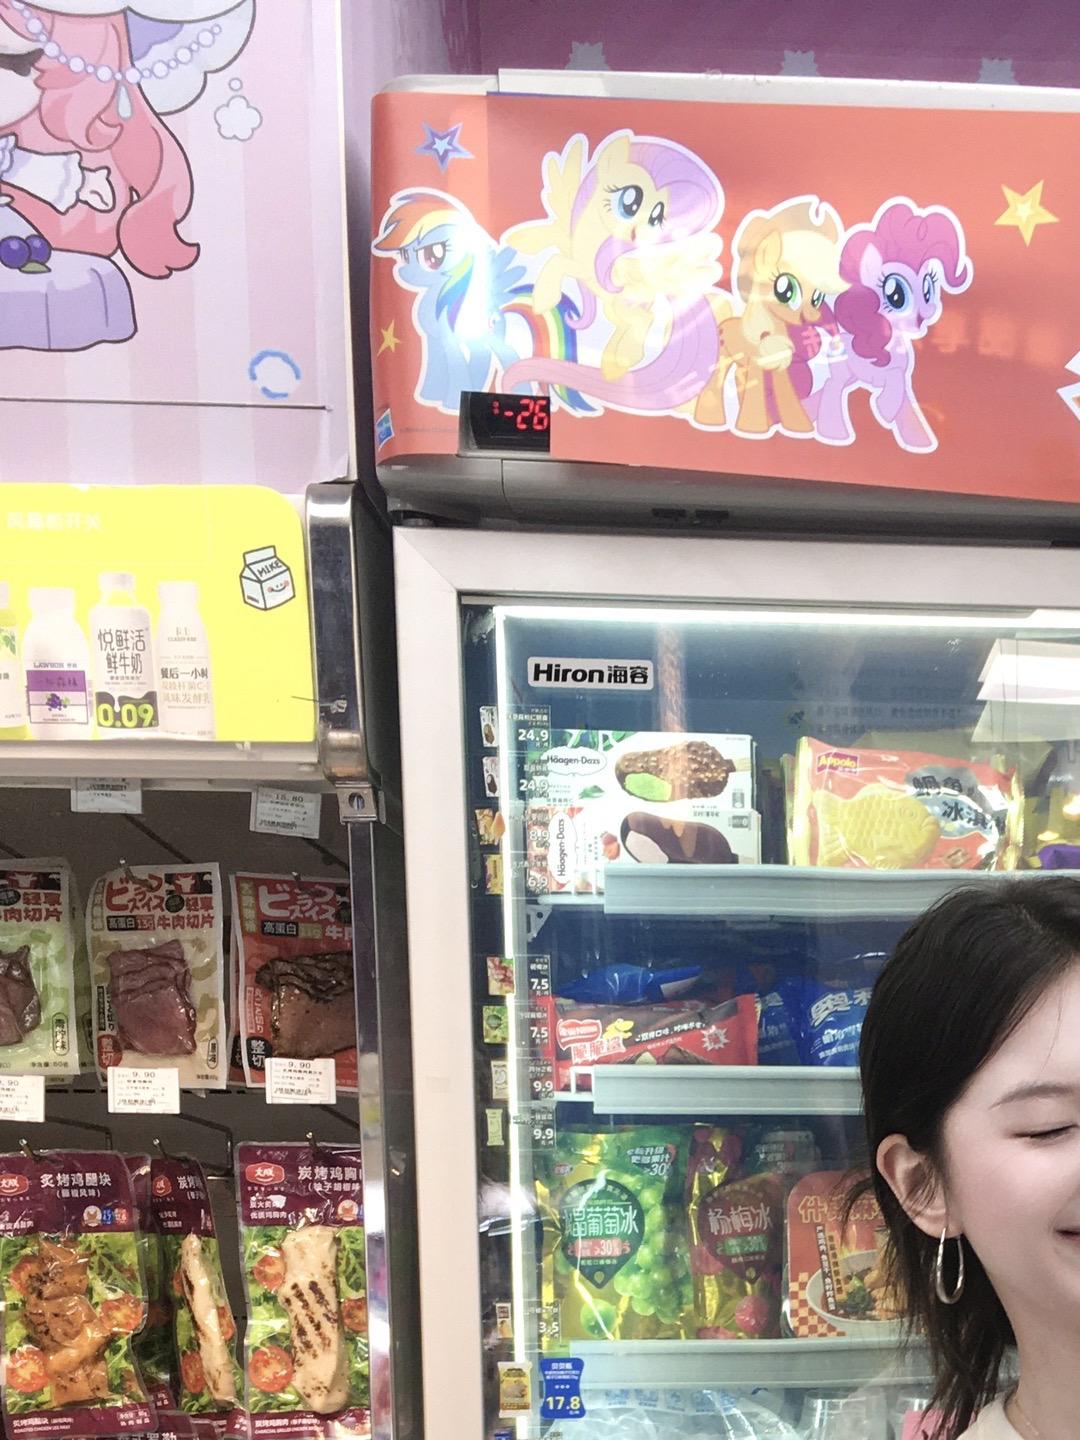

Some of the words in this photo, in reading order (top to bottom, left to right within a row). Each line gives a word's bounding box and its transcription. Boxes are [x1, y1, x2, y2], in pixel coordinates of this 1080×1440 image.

[98, 629, 146, 652] 悦鲜活
[105, 652, 143, 674] 鲜牛奶
[533, 663, 605, 684] Hiron
[607, 664, 649, 685] 海容
[97, 703, 154, 727] 0.09
[518, 729, 549, 741] 24.9
[530, 978, 550, 990] 7.5
[530, 1026, 549, 1038] 7.5
[533, 1080, 554, 1092] 9.9
[533, 1128, 554, 1141] 9.9
[297, 1165, 363, 1180] 炭烤鸡胸
[40, 1172, 113, 1188] 炙烤鸡腿块
[546, 1396, 581, 1410] 17.8
